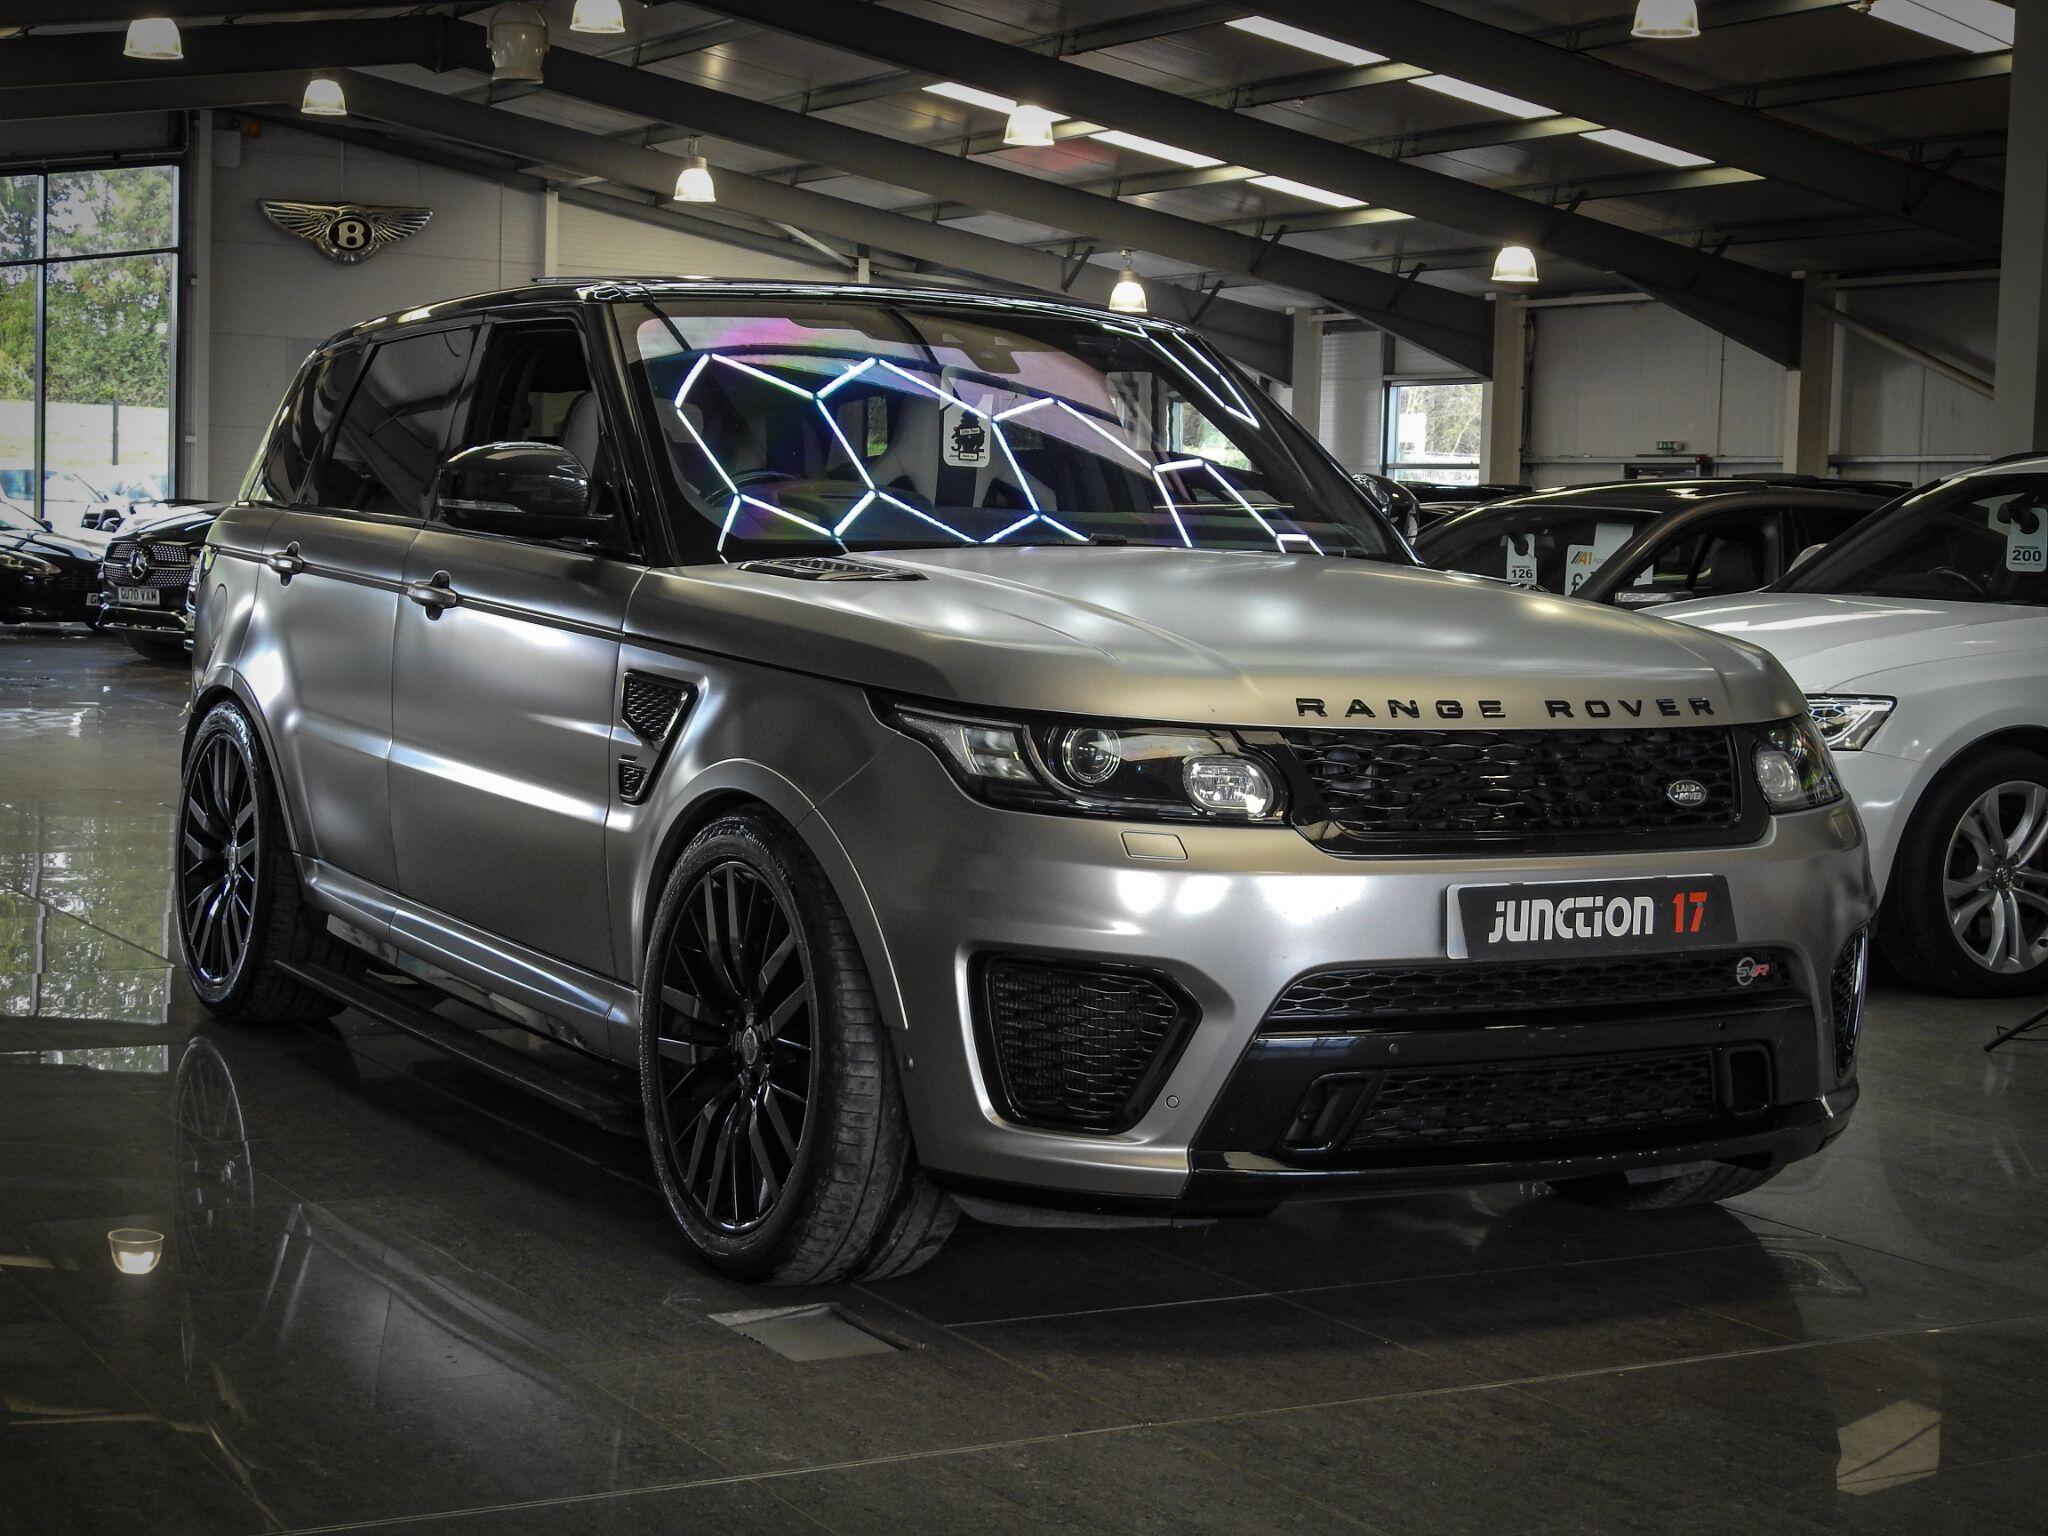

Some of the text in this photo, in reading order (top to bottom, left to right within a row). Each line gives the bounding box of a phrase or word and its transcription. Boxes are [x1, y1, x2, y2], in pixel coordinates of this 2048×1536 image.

[338, 220, 365, 248] B
[2012, 549, 2042, 562] 200
[1511, 568, 1533, 579] 126
[1296, 697, 1715, 719] RANGE ROVER
[1676, 784, 1695, 792] LAND
[1679, 792, 1702, 800] ROVER
[1672, 891, 1708, 933] 17
